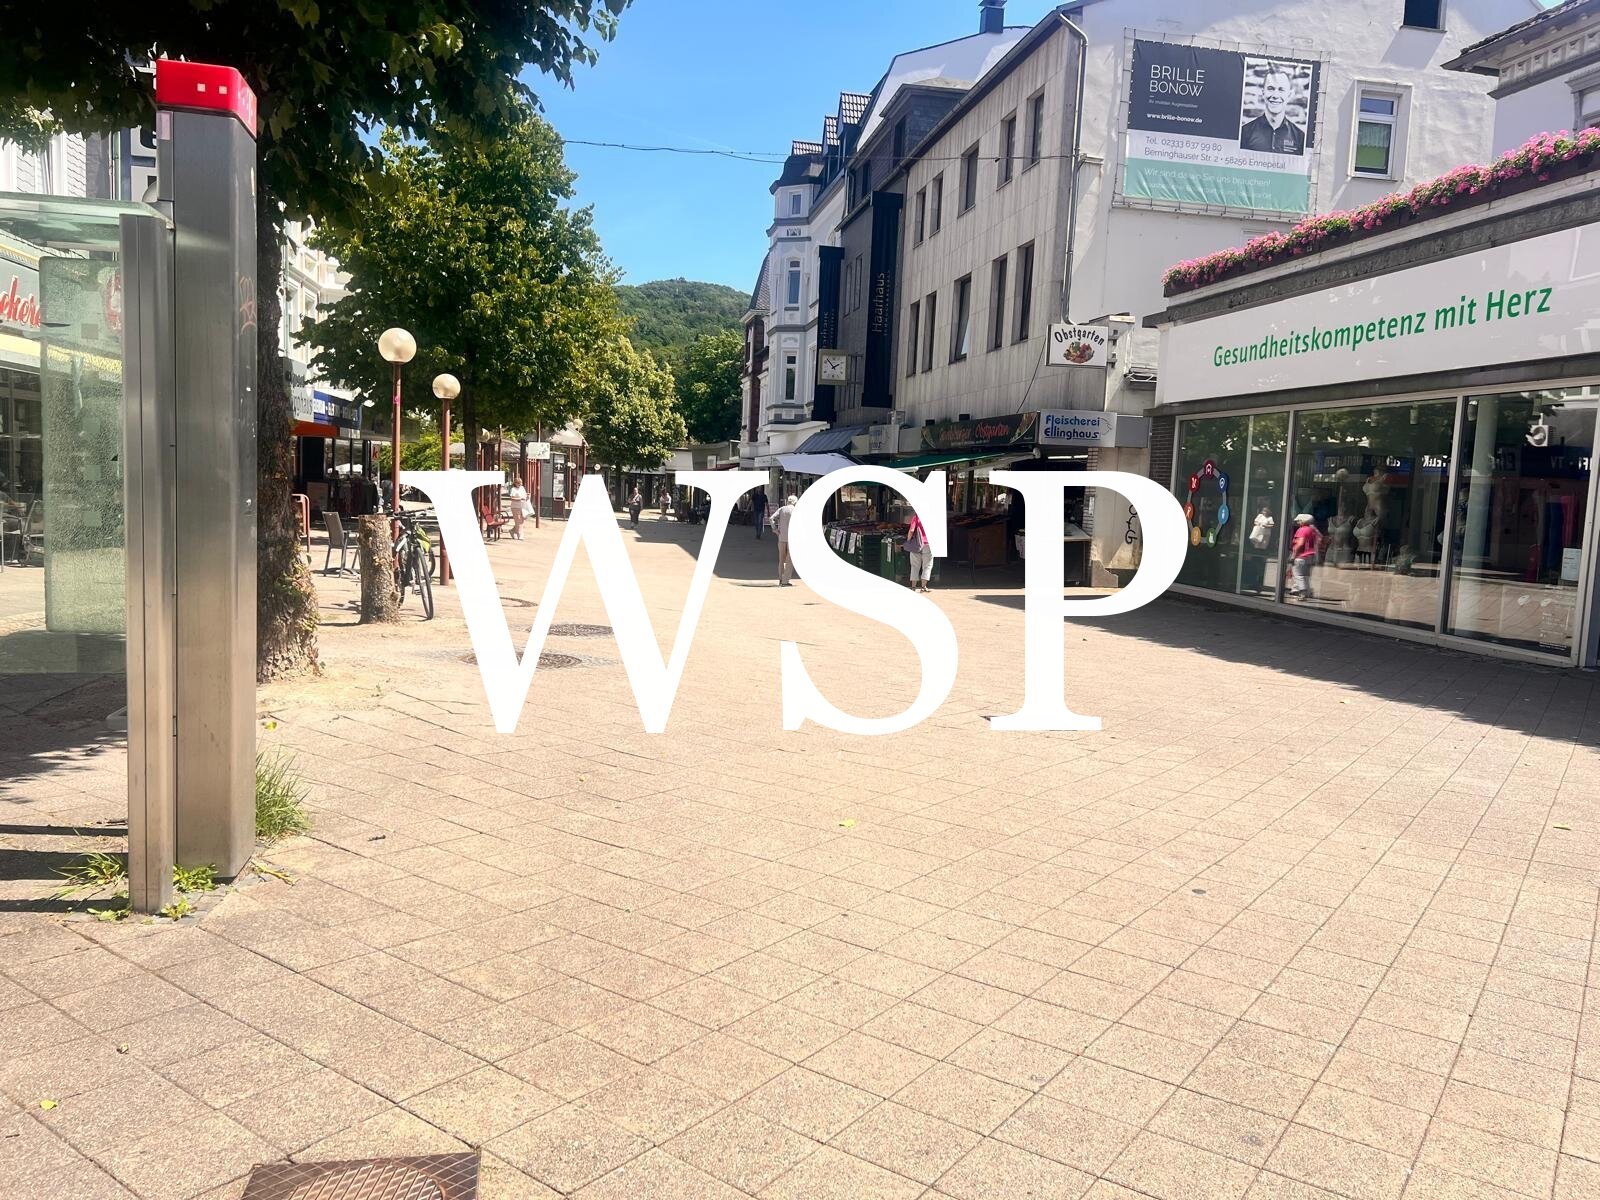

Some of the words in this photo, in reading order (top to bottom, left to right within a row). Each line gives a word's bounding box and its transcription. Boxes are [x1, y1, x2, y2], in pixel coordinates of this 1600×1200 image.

[1151, 64, 1205, 84] BRILLE
[1149, 79, 1203, 97] BONOW
[1146, 113, 1203, 123] www.brille-bonow.de
[1161, 138, 1184, 149] 02333
[1185, 140, 1199, 150] 637
[1200, 142, 1211, 152] 99
[1212, 142, 1223, 152] 80
[1144, 147, 1199, 161] Berninghauser
[1213, 155, 1219, 163] 2
[1248, 157, 1286, 170] Ennepetal
[1144, 167, 1158, 176] Wir
[871, 272, 885, 333] Haarhaus
[1214, 312, 1426, 367] Gesundheitskompetenz
[1435, 295, 1477, 331] mit
[1486, 287, 1552, 322] Herz
[1054, 327, 1105, 346] Obstgarten
[1045, 414, 1100, 427] Fleischerei
[1043, 426, 1100, 440] Ellinghaus
